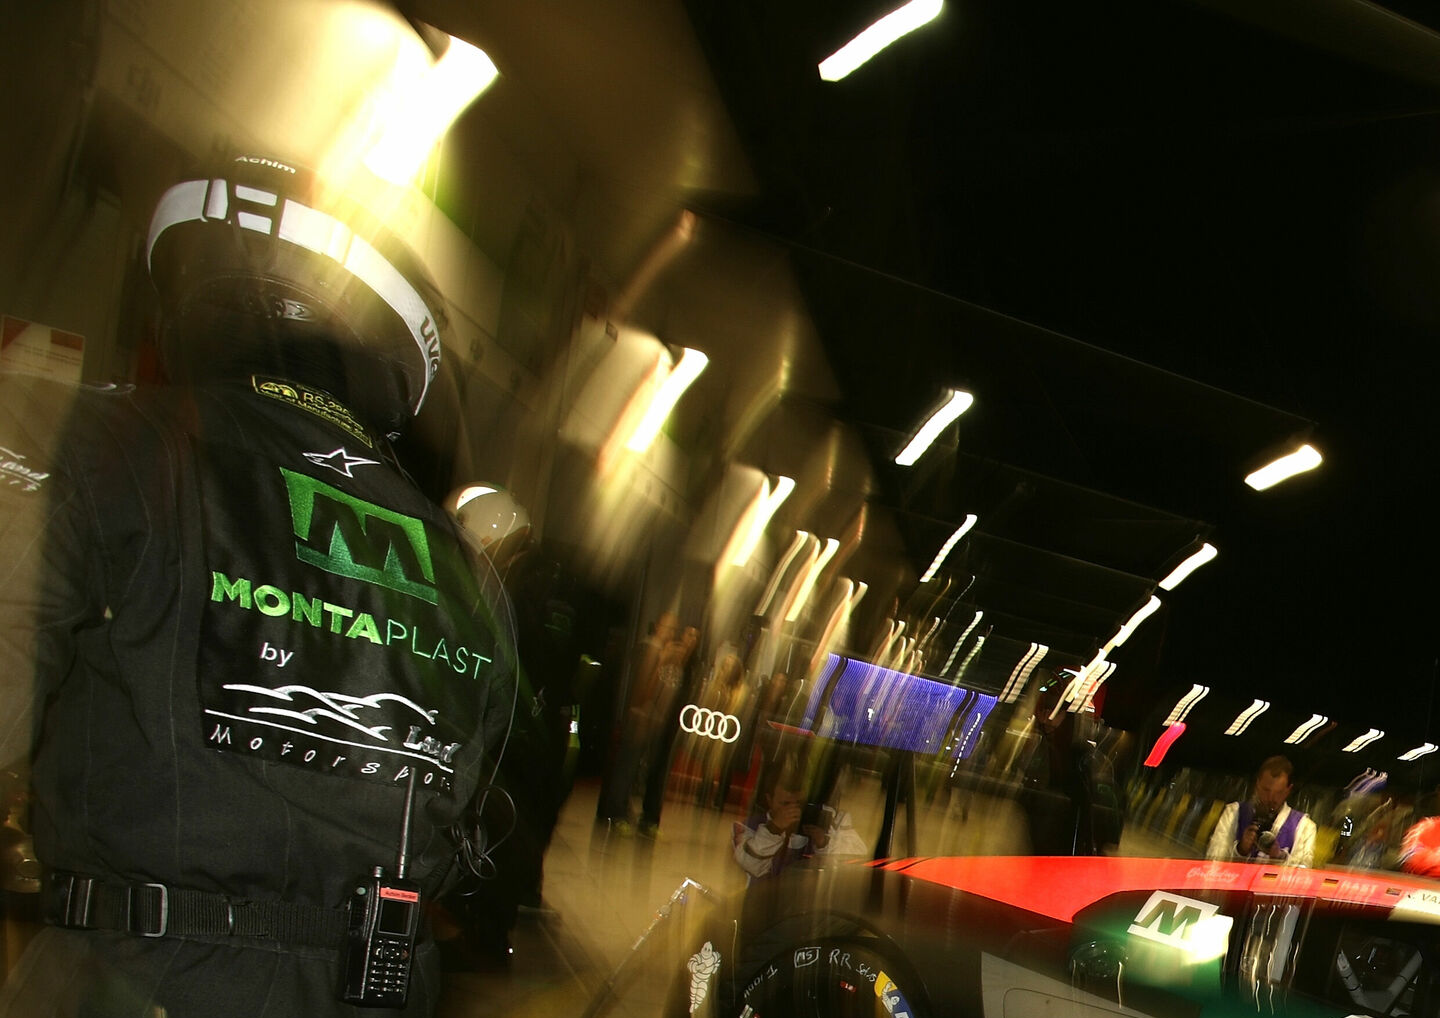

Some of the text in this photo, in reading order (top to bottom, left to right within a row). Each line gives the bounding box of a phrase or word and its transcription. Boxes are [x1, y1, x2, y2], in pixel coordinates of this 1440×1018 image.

[235, 156, 296, 174] Achim
[211, 571, 492, 679] MONTAPLAST
[259, 641, 294, 667] by
